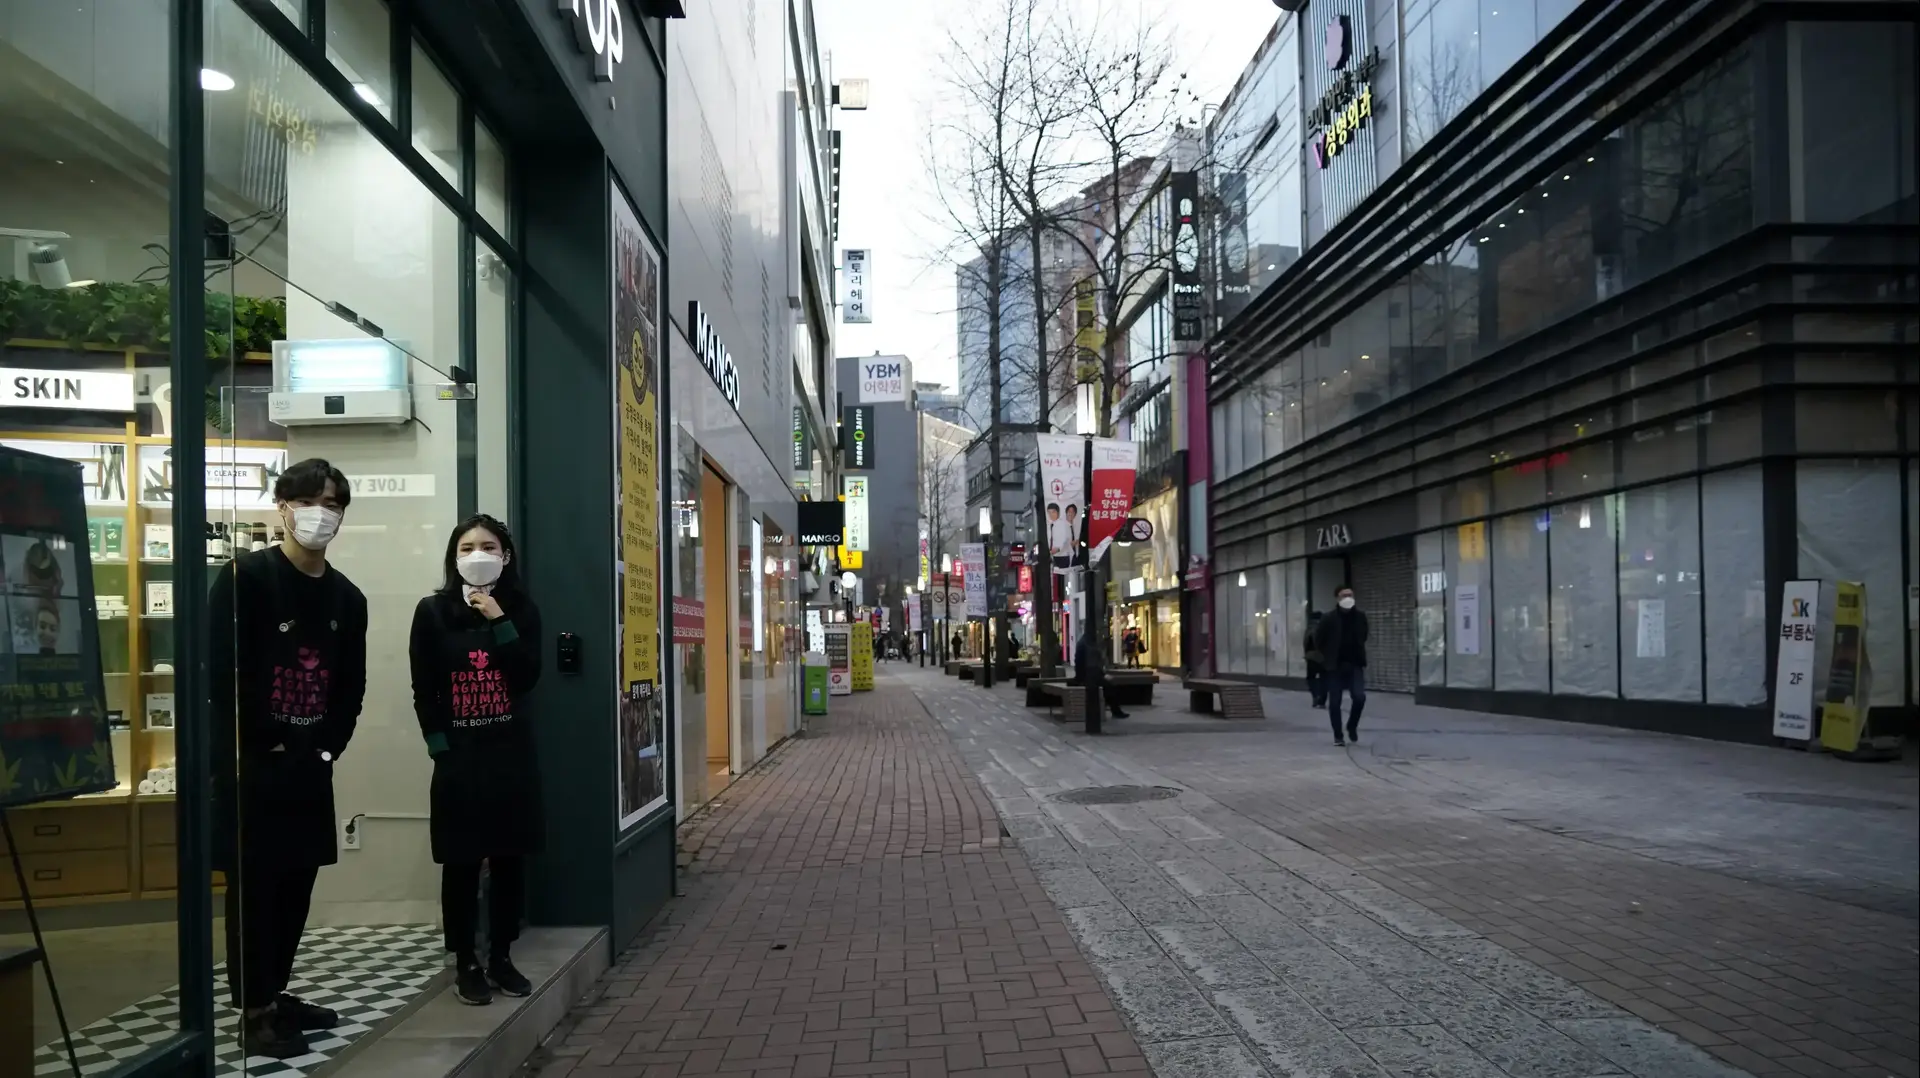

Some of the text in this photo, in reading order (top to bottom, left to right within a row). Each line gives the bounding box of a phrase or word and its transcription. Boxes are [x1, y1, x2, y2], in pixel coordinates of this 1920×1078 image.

[851, 262, 863, 314] 토리헤어
[697, 300, 739, 411] MANGO
[865, 363, 901, 379] YBM
[14, 376, 82, 400] SKIN
[864, 380, 901, 395] 어학원
[1101, 499, 1128, 509] 당신이
[802, 534, 841, 543] MANGO
[1317, 525, 1351, 550] ZARA
[1782, 624, 1816, 642] 부동산
[1790, 672, 1804, 686] 2F
[452, 719, 468, 728] THE
[470, 717, 492, 727] BODY
